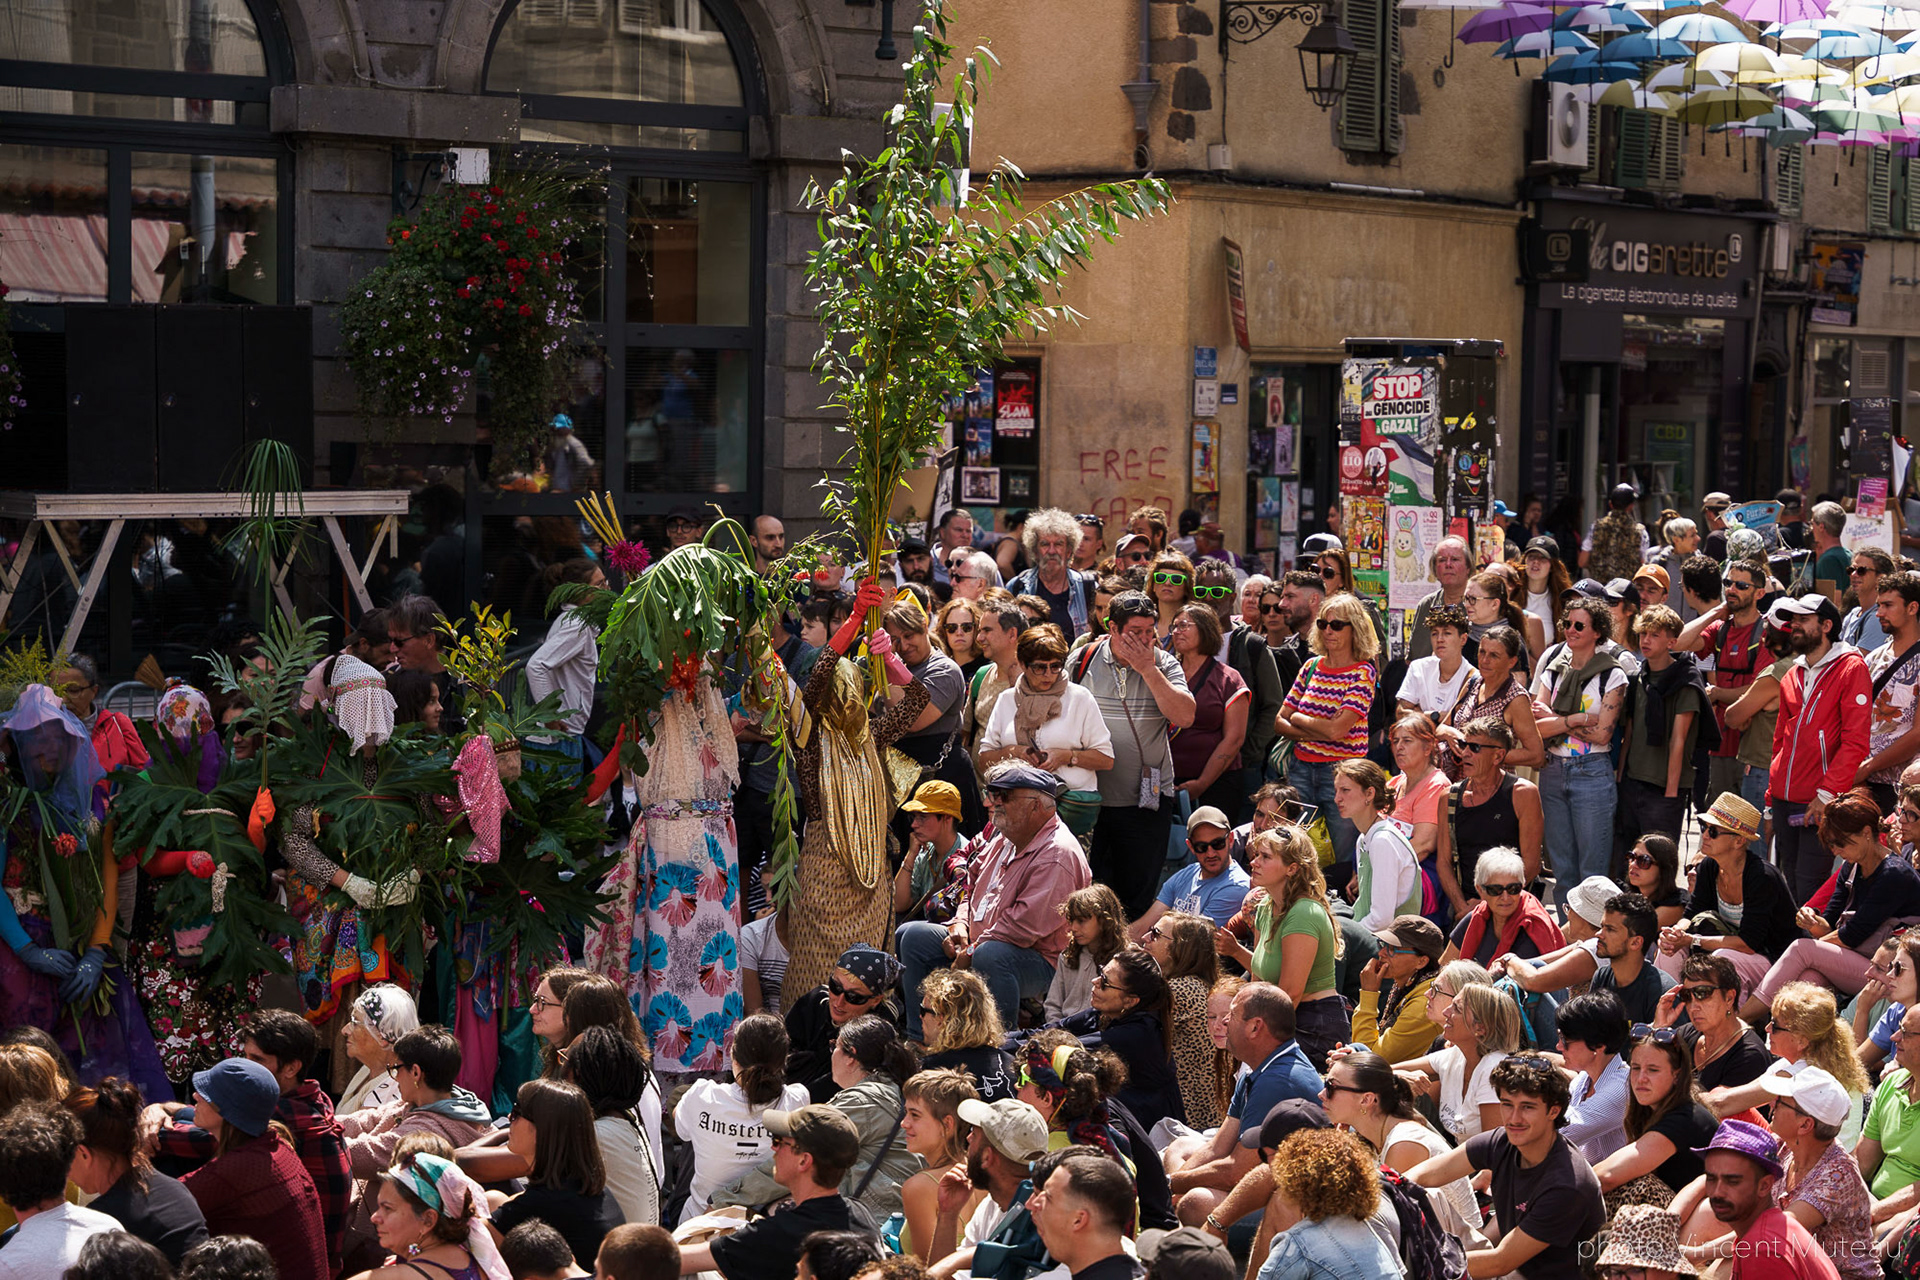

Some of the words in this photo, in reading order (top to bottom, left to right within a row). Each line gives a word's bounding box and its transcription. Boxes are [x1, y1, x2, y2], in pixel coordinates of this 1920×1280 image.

[1561, 283, 1575, 299] La
[1579, 284, 1625, 304] cigarette
[1628, 286, 1690, 306] électronique
[1691, 289, 1704, 306] de
[1706, 290, 1738, 309] qualité
[1373, 376, 1422, 399] STOP
[998, 404, 1031, 418] SLAM
[1654, 424, 1687, 440] CBD
[1079, 446, 1168, 485] FREE
[1343, 456, 1362, 466] 110
